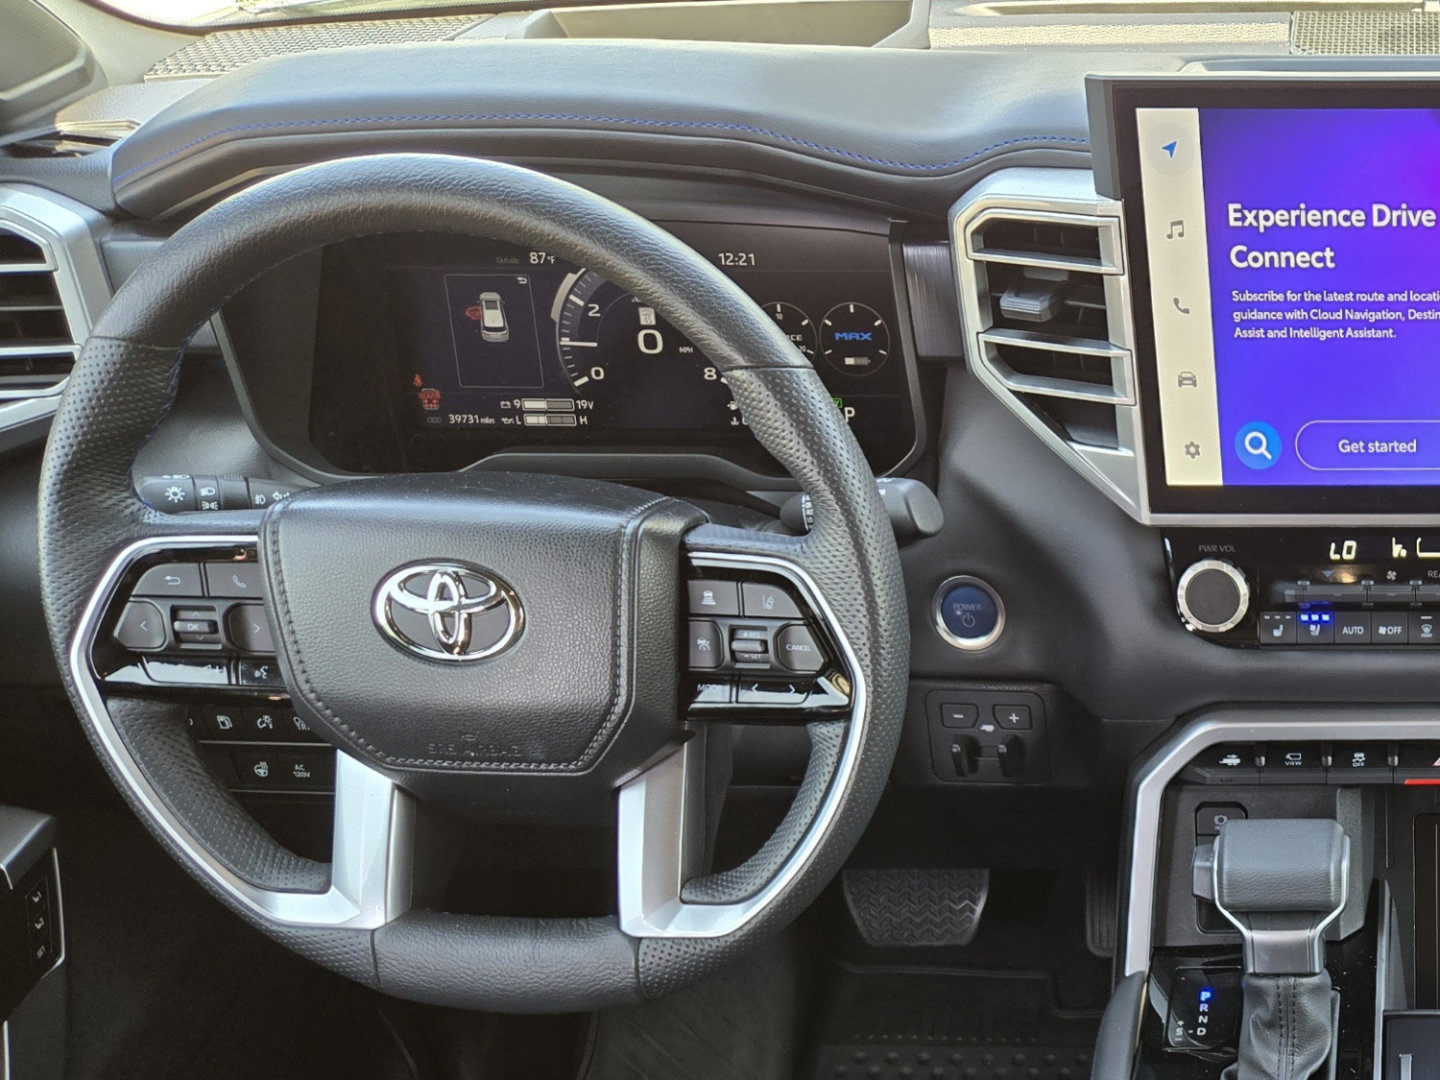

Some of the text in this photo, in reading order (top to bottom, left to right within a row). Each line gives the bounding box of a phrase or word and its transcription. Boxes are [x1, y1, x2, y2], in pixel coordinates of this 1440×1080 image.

[1228, 203, 1437, 233] Experience Drive
[718, 253, 756, 266] 12:21
[1230, 245, 1336, 268] Connect
[1232, 290, 1285, 301] Subscribe
[1286, 290, 1302, 301] for
[1303, 290, 1322, 301] the
[1323, 290, 1354, 301] latest
[1356, 292, 1385, 301] route
[1387, 290, 1408, 301] and
[588, 304, 601, 317] 2
[1233, 309, 1283, 323] guidance
[1285, 309, 1308, 320] with
[1310, 309, 1343, 320] Cloud
[1345, 309, 1406, 323] Navigation,
[834, 332, 873, 341] MAX
[1234, 327, 1397, 340] Assist and Intelligent Assistant.
[637, 329, 663, 355] 0
[591, 367, 605, 380] 0
[704, 367, 717, 381] 8
[449, 414, 480, 424] 39731
[845, 407, 856, 422] P
[1338, 438, 1417, 454] Get started
[1198, 545, 1236, 553] PWR VOL
[1329, 540, 1357, 560] LO
[187, 623, 200, 631] OK
[1342, 626, 1364, 635] AUTO
[1387, 626, 1403, 635] OFF
[786, 643, 812, 652] CANCEL
[1200, 991, 1211, 1001] P
[1199, 1003, 1208, 1012] R
[1199, 1015, 1208, 1024] N
[1196, 1027, 1206, 1036] D
